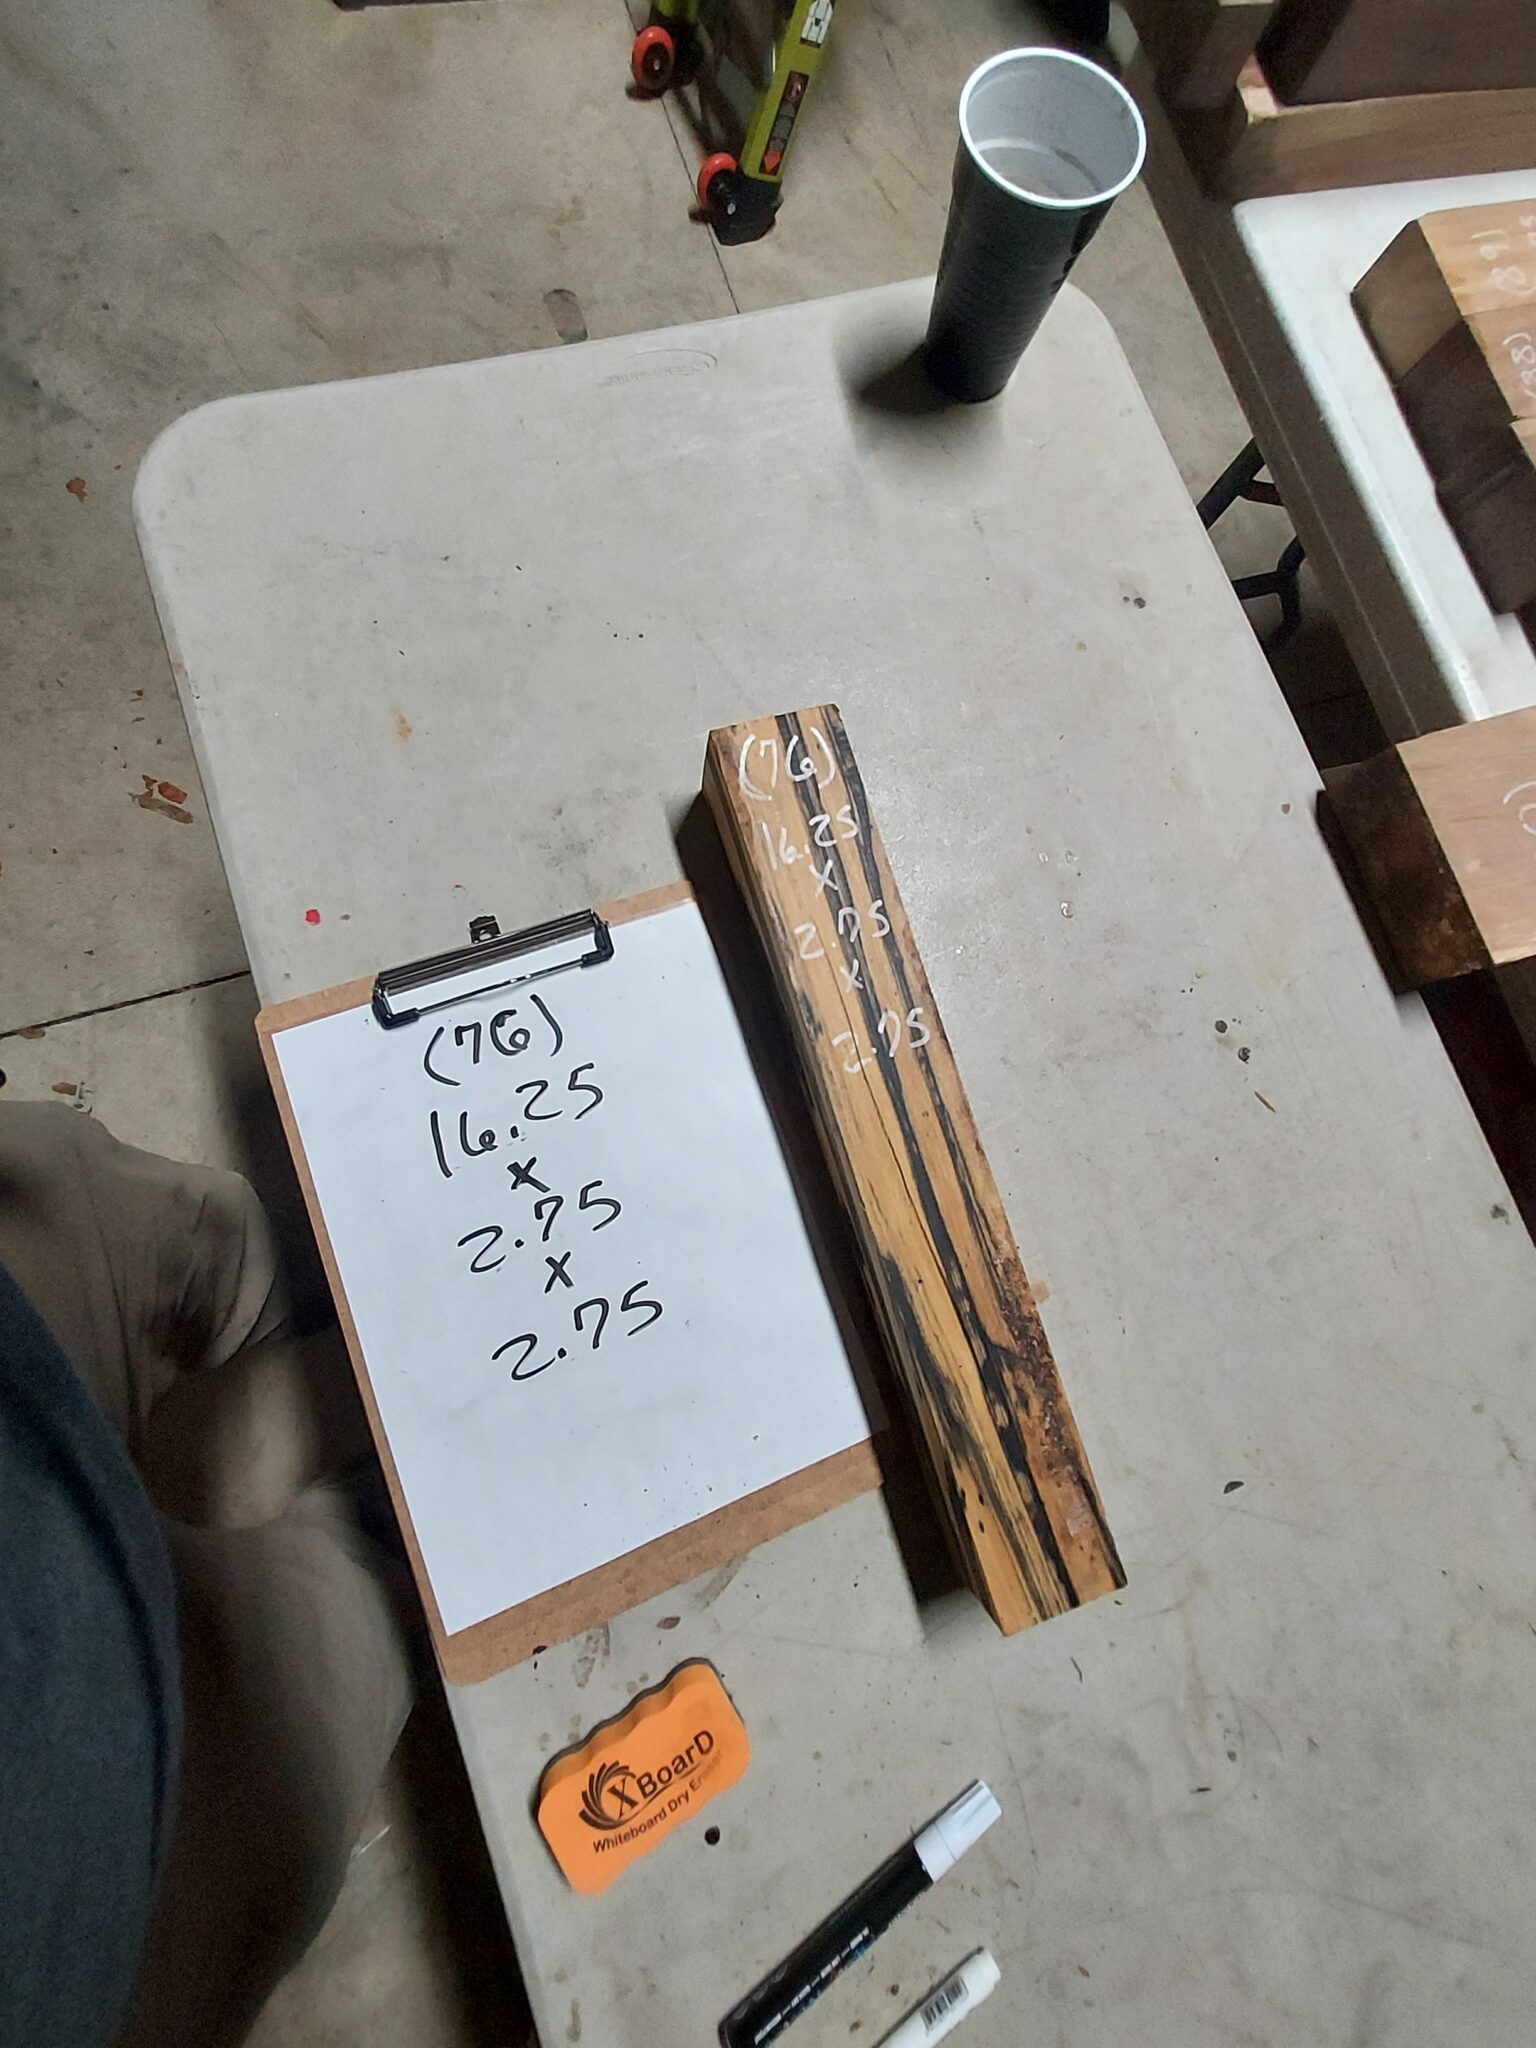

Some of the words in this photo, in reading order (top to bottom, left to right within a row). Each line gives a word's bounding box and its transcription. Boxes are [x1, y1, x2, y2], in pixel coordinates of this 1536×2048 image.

[738, 726, 836, 801] (76)
[423, 993, 564, 1087] (76)
[429, 1061, 605, 1179] 16.25
[456, 1180, 623, 1275] 2.75
[491, 1279, 664, 1382] 2.75
[592, 1807, 668, 1855] Whiteboard
[667, 1788, 691, 1813] Dry
